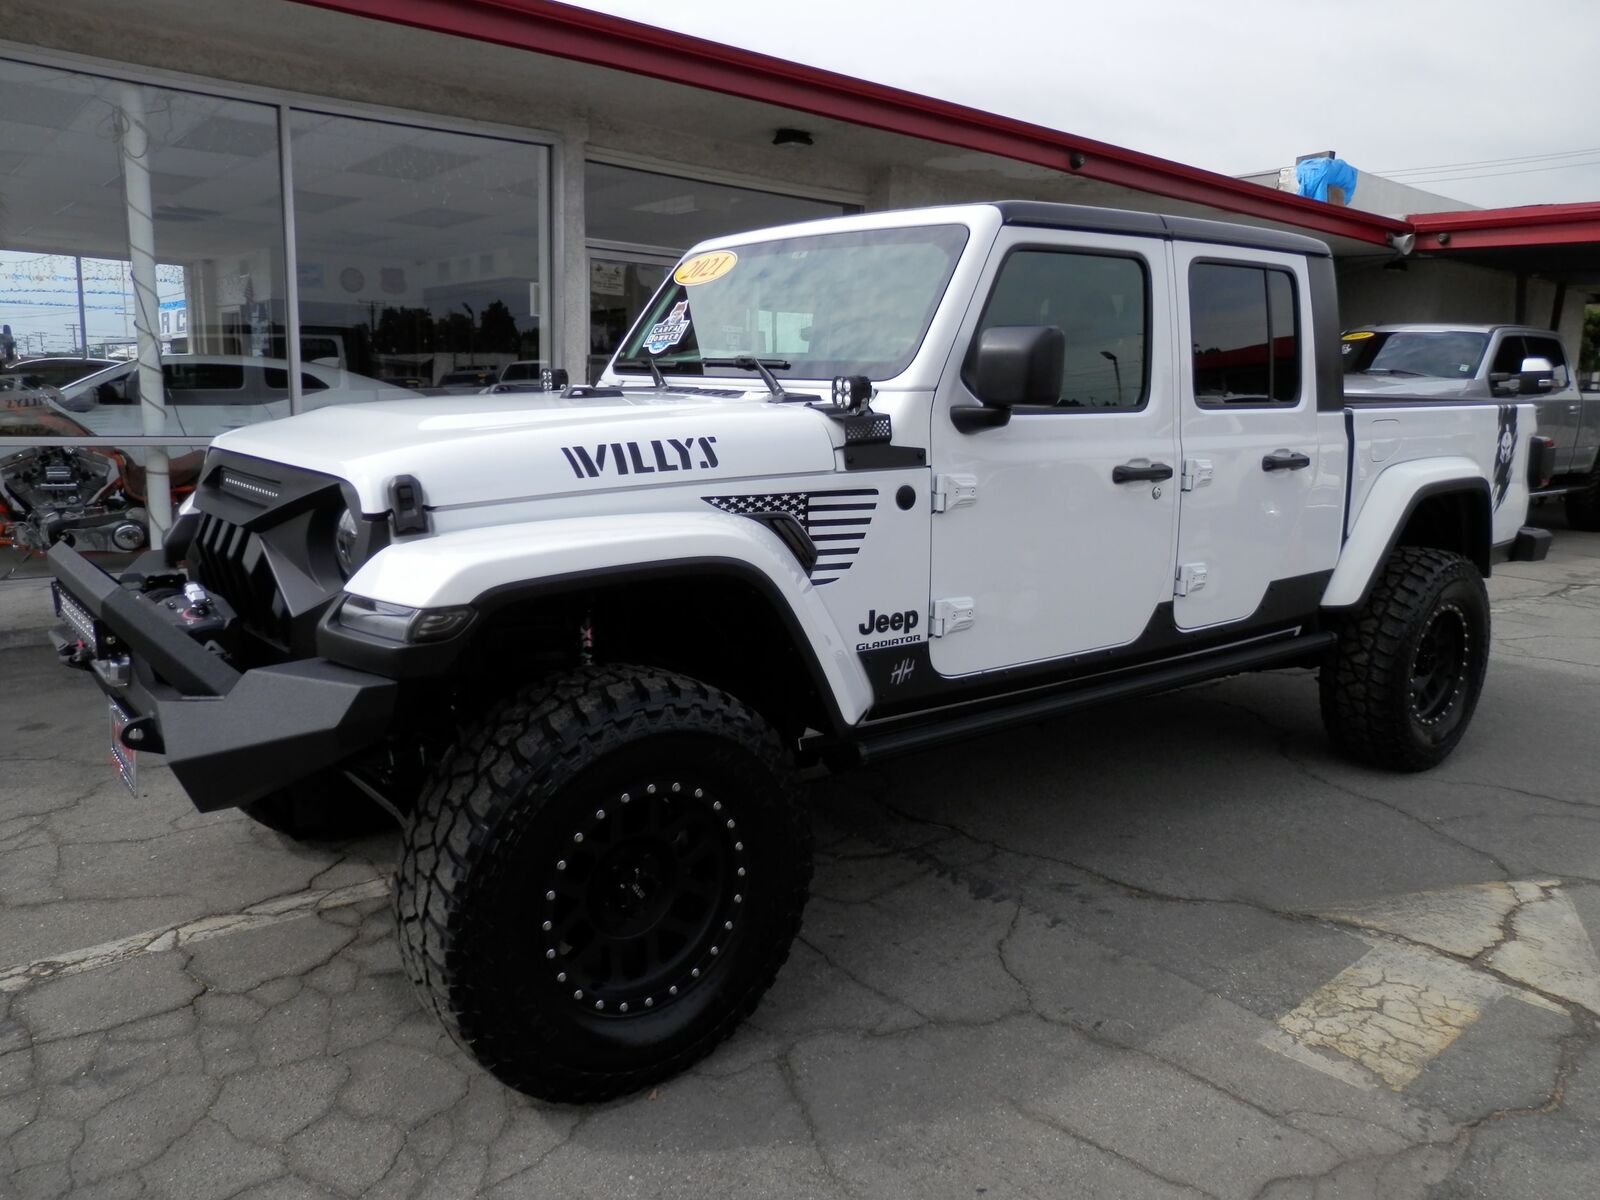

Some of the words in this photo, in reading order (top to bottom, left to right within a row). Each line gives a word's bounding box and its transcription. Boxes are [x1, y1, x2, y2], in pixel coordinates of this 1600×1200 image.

[680, 255, 730, 280] 2021
[561, 436, 719, 479] WILLYS
[859, 609, 919, 636] Jeep
[856, 634, 921, 651] GLADIATOR
